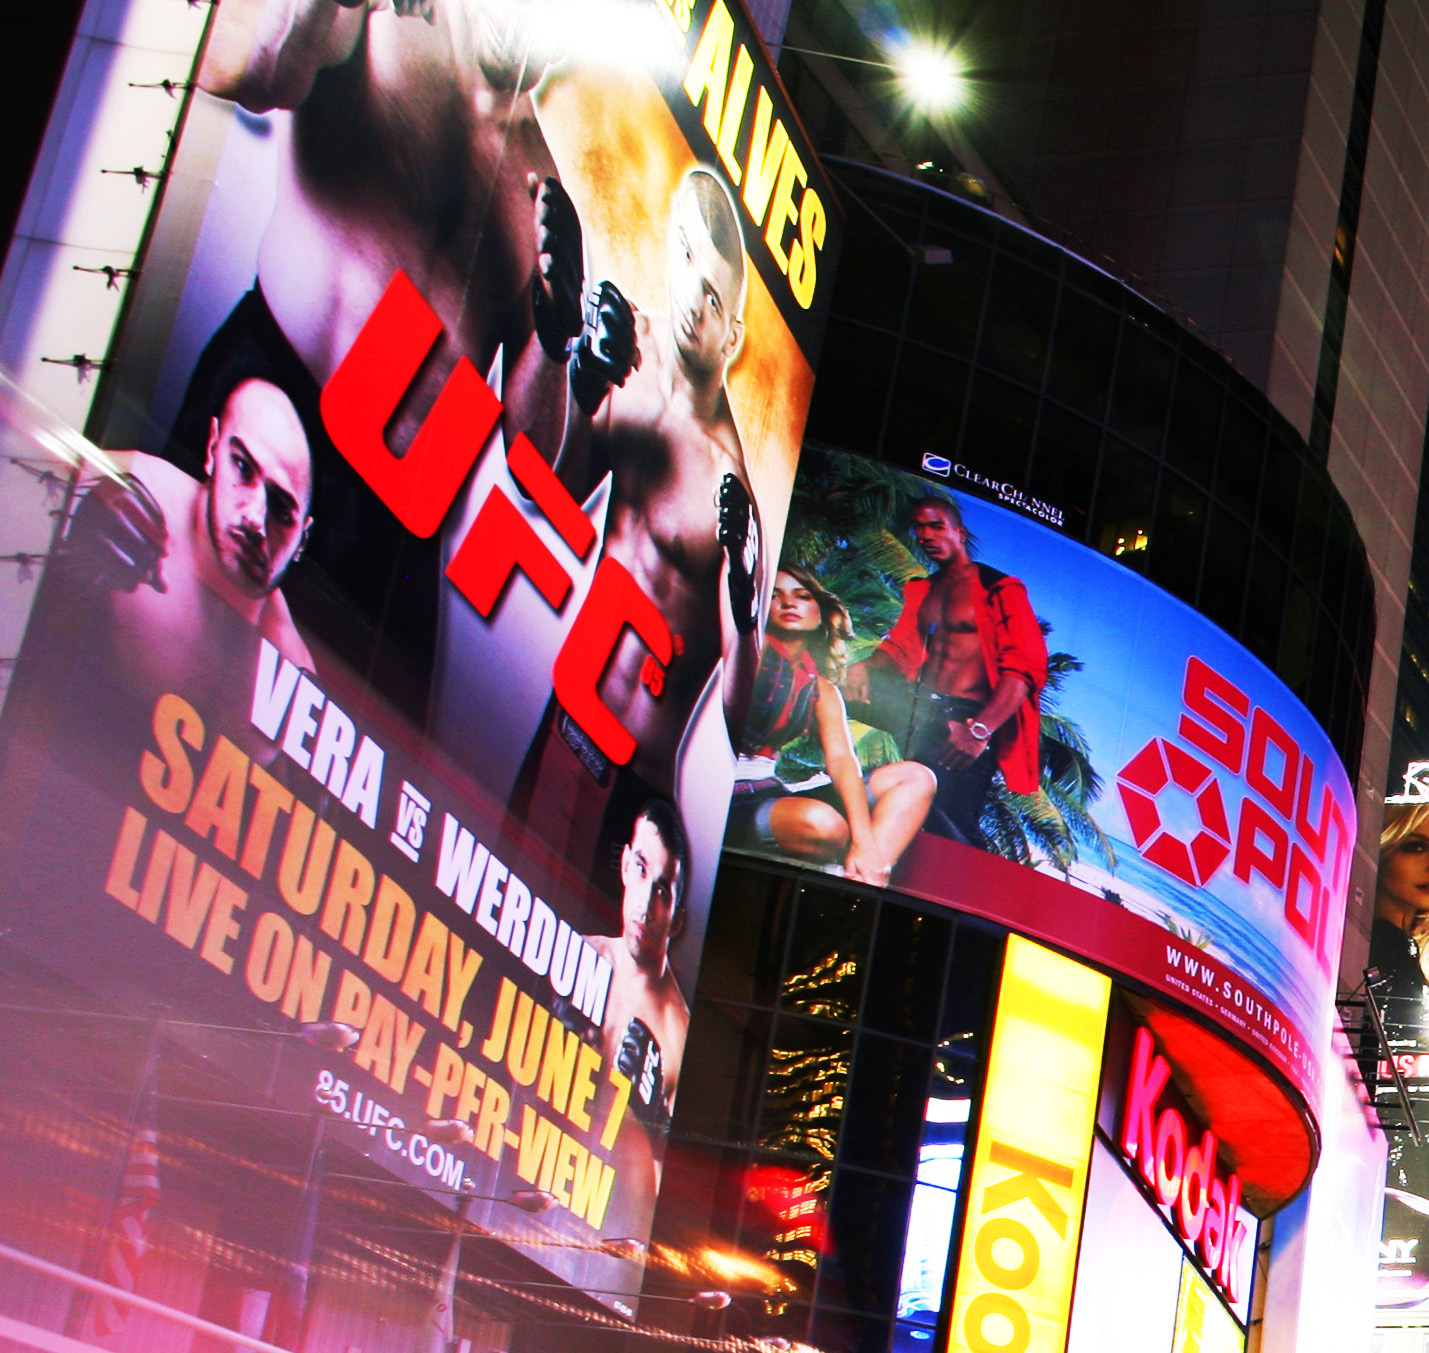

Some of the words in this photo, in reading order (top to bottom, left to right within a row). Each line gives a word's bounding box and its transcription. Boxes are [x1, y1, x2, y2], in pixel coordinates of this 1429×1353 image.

[683, 0, 827, 310] ALVES
[320, 268, 674, 766] UFC
[251, 638, 386, 830] VERA
[436, 813, 614, 1028] WERDUM
[1178, 654, 1355, 868] SOUT
[1233, 796, 1342, 975] POL
[105, 806, 250, 976] LIVE
[246, 912, 332, 1028] ON
[330, 976, 616, 1231] PAY-PER-VIEW
[139, 693, 486, 1049] SATURDAY,
[483, 976, 606, 1132] JUNE
[602, 1070, 632, 1152] 7
[315, 1069, 467, 1193] 85.UFC.COM
[1120, 1024, 1249, 1305] Kodak
